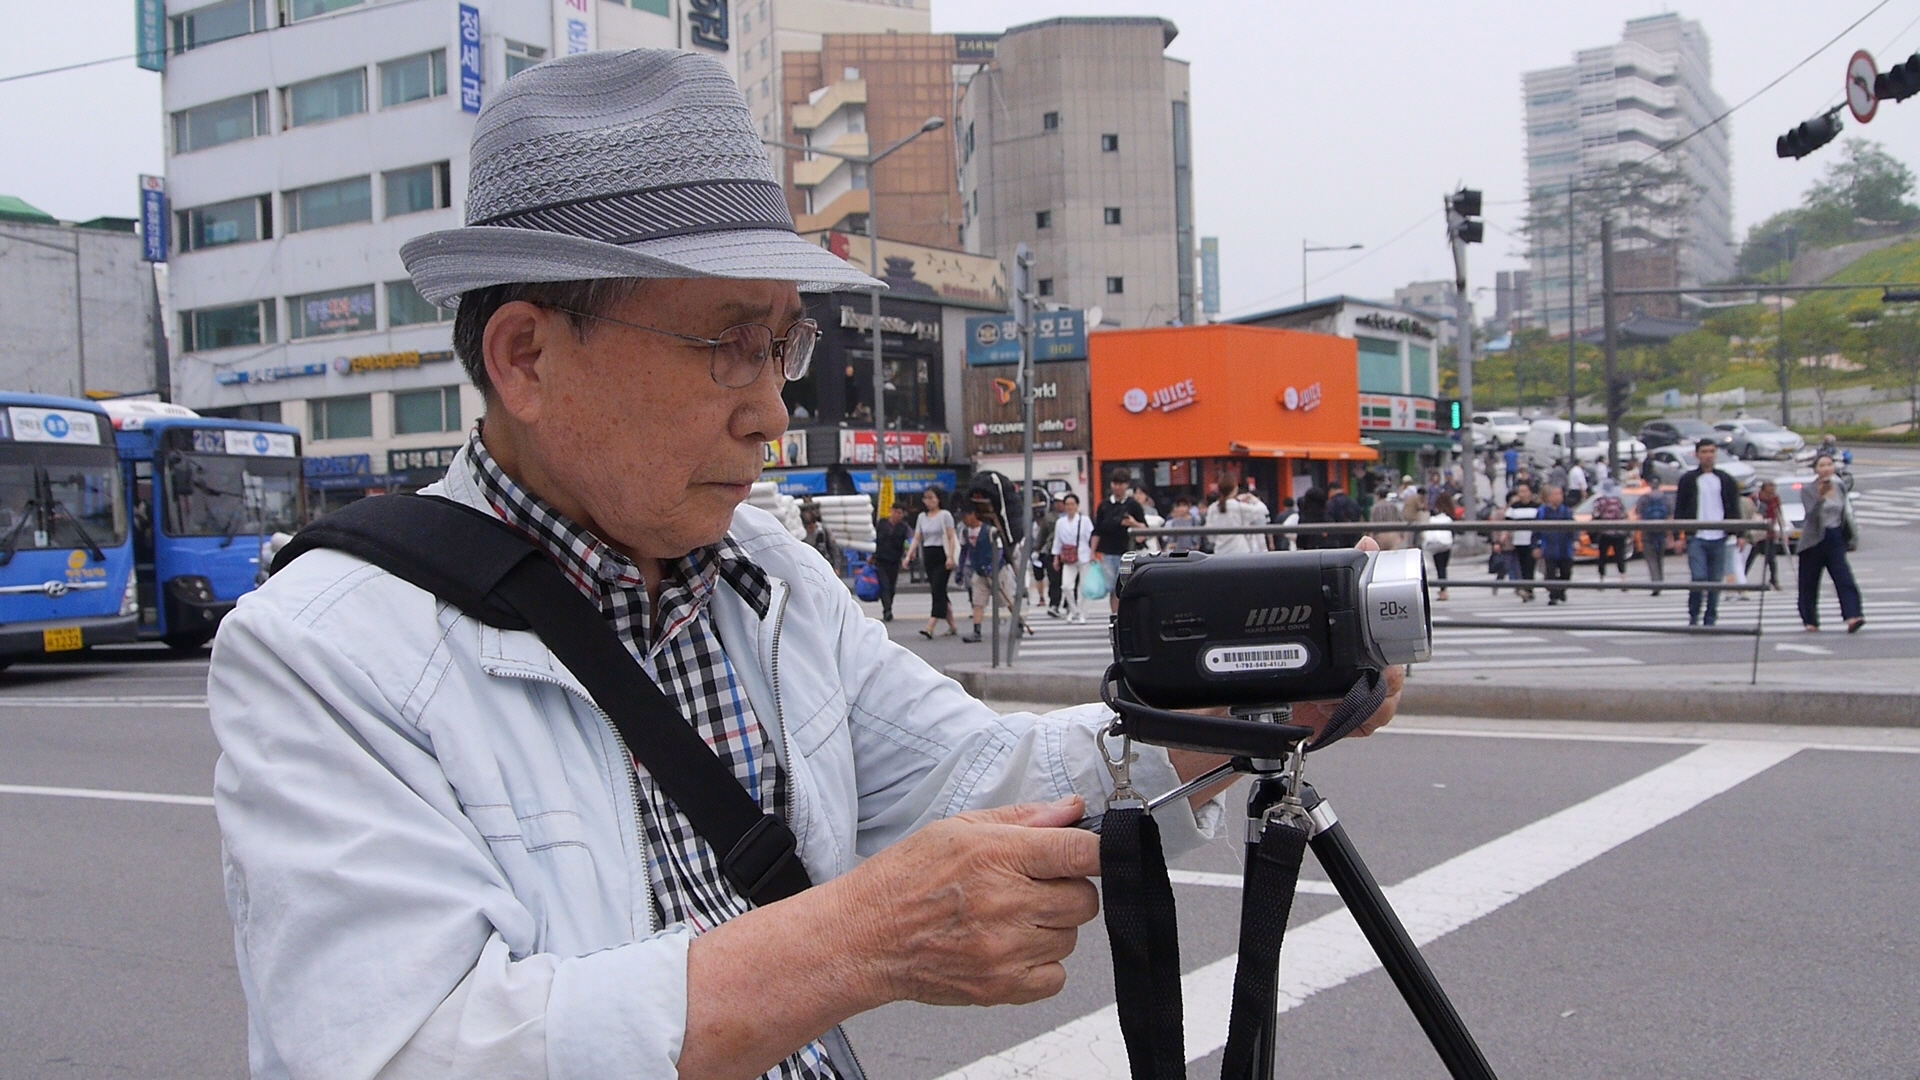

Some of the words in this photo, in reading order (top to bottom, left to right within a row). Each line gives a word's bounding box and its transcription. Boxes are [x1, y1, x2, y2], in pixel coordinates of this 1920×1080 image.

[461, 9, 480, 109] 정세균
[1002, 317, 1075, 341] 광호프
[1151, 378, 1197, 408] JUICE
[1299, 382, 1322, 408] JUICE
[1038, 419, 1064, 432] olleh
[193, 429, 225, 452] 262
[1244, 604, 1313, 627] HDD
[1379, 601, 1408, 617] 20x
[1245, 626, 1267, 634] HARD
[1288, 622, 1311, 631] DRIVE
